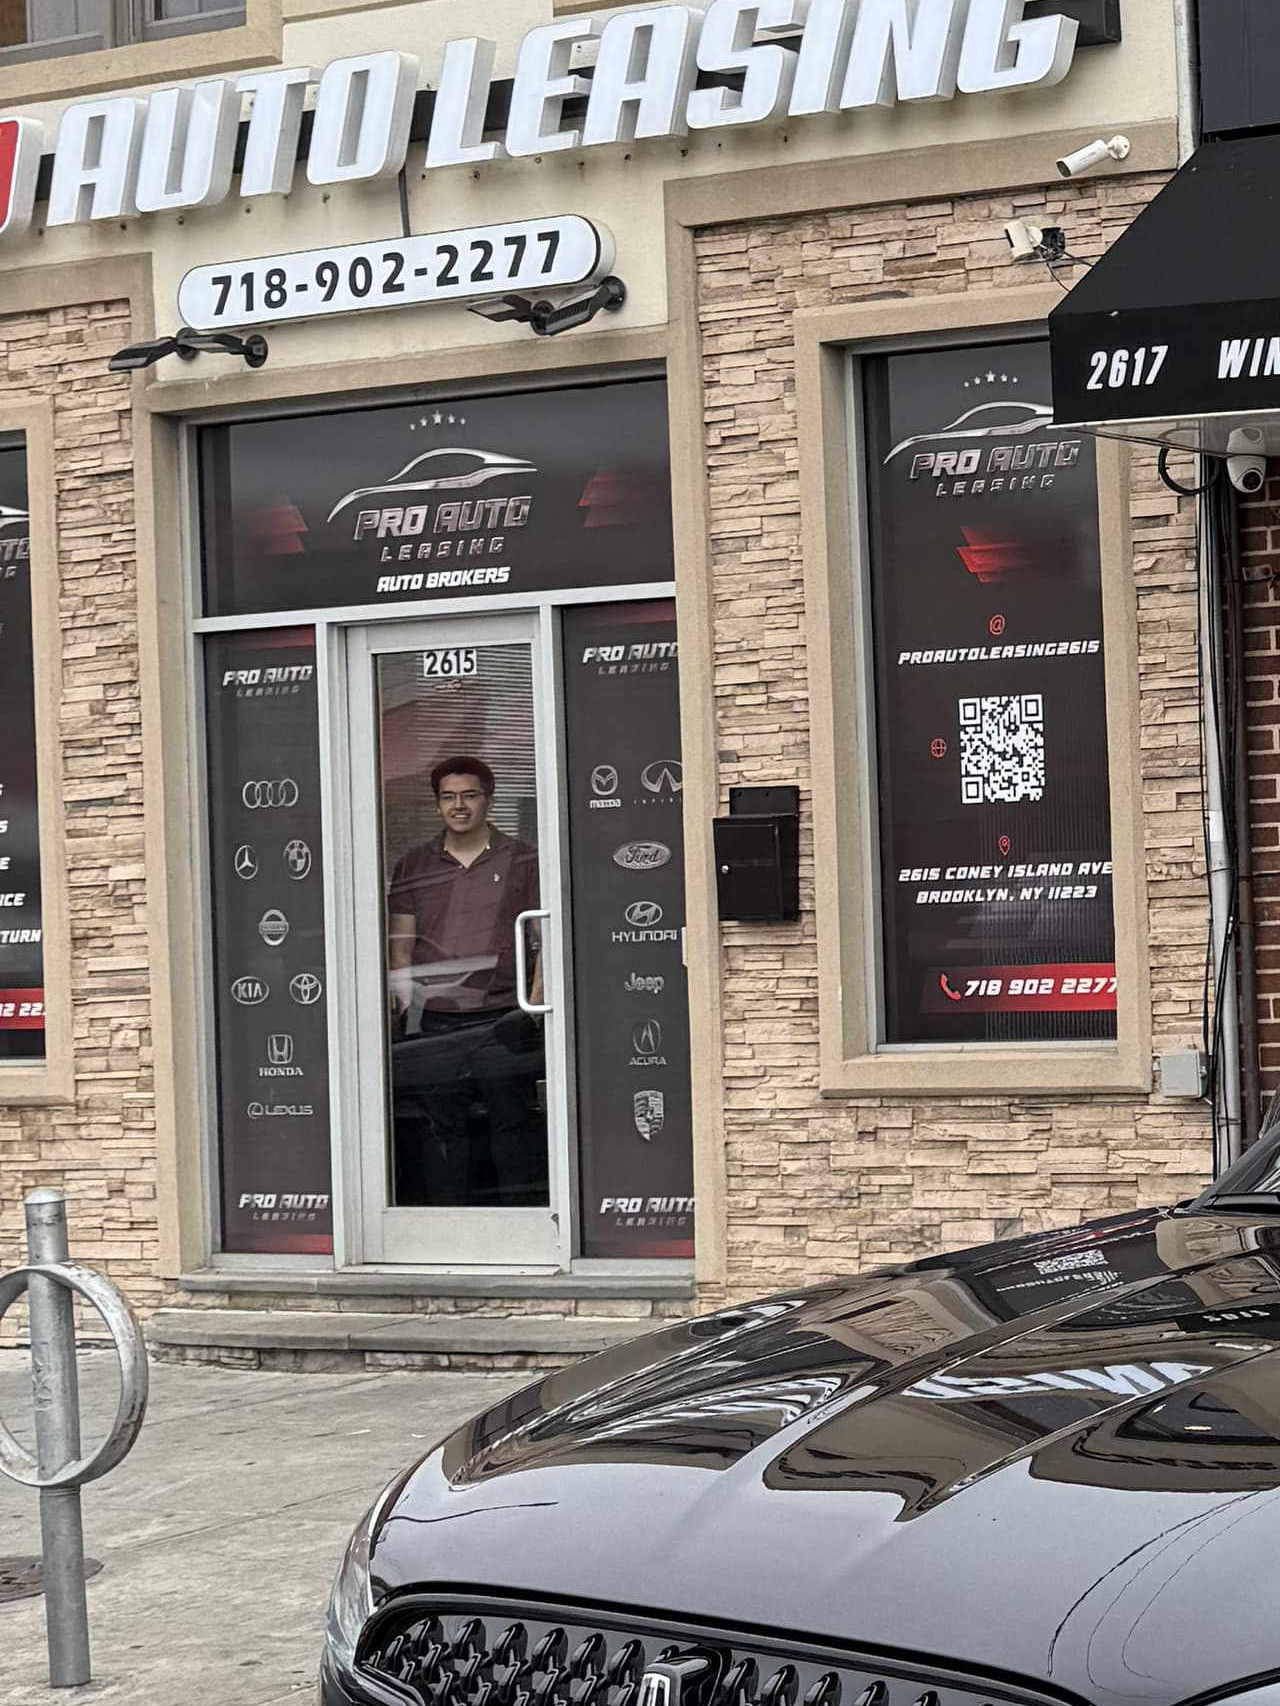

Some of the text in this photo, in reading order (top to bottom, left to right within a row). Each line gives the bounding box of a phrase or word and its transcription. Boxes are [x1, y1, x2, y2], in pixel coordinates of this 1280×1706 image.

[47, 50, 418, 226] AUTO
[210, 231, 563, 317] 718-902-2277
[1085, 345, 1169, 391] 2617
[909, 440, 1081, 480] PRO AUTO
[936, 474, 1055, 497] LEASING
[354, 495, 533, 541] PRO AUTO
[380, 536, 505, 563] LEASING
[376, 566, 510, 593] AUTO BROKERS
[426, 650, 474, 675] 2615
[582, 646, 624, 664] PRO
[898, 640, 1100, 665] PROAUTOLEASING2615
[222, 665, 313, 686] PRO AUTO
[898, 861, 1113, 882] 2615 CONEY ISLAND AVE
[1020, 887, 1044, 901] NY
[1048, 885, 1097, 899] 11223
[612, 930, 677, 943] HYUNDAI
[625, 973, 664, 993] Jeep
[964, 980, 1002, 997] 718
[1007, 978, 1054, 995] 902
[259, 1066, 304, 1077] HONDA
[629, 1056, 667, 1066] ACURA
[265, 1103, 313, 1116] LEXUS
[239, 1193, 329, 1209] PRO AUTO
[600, 1196, 643, 1214] PRO
